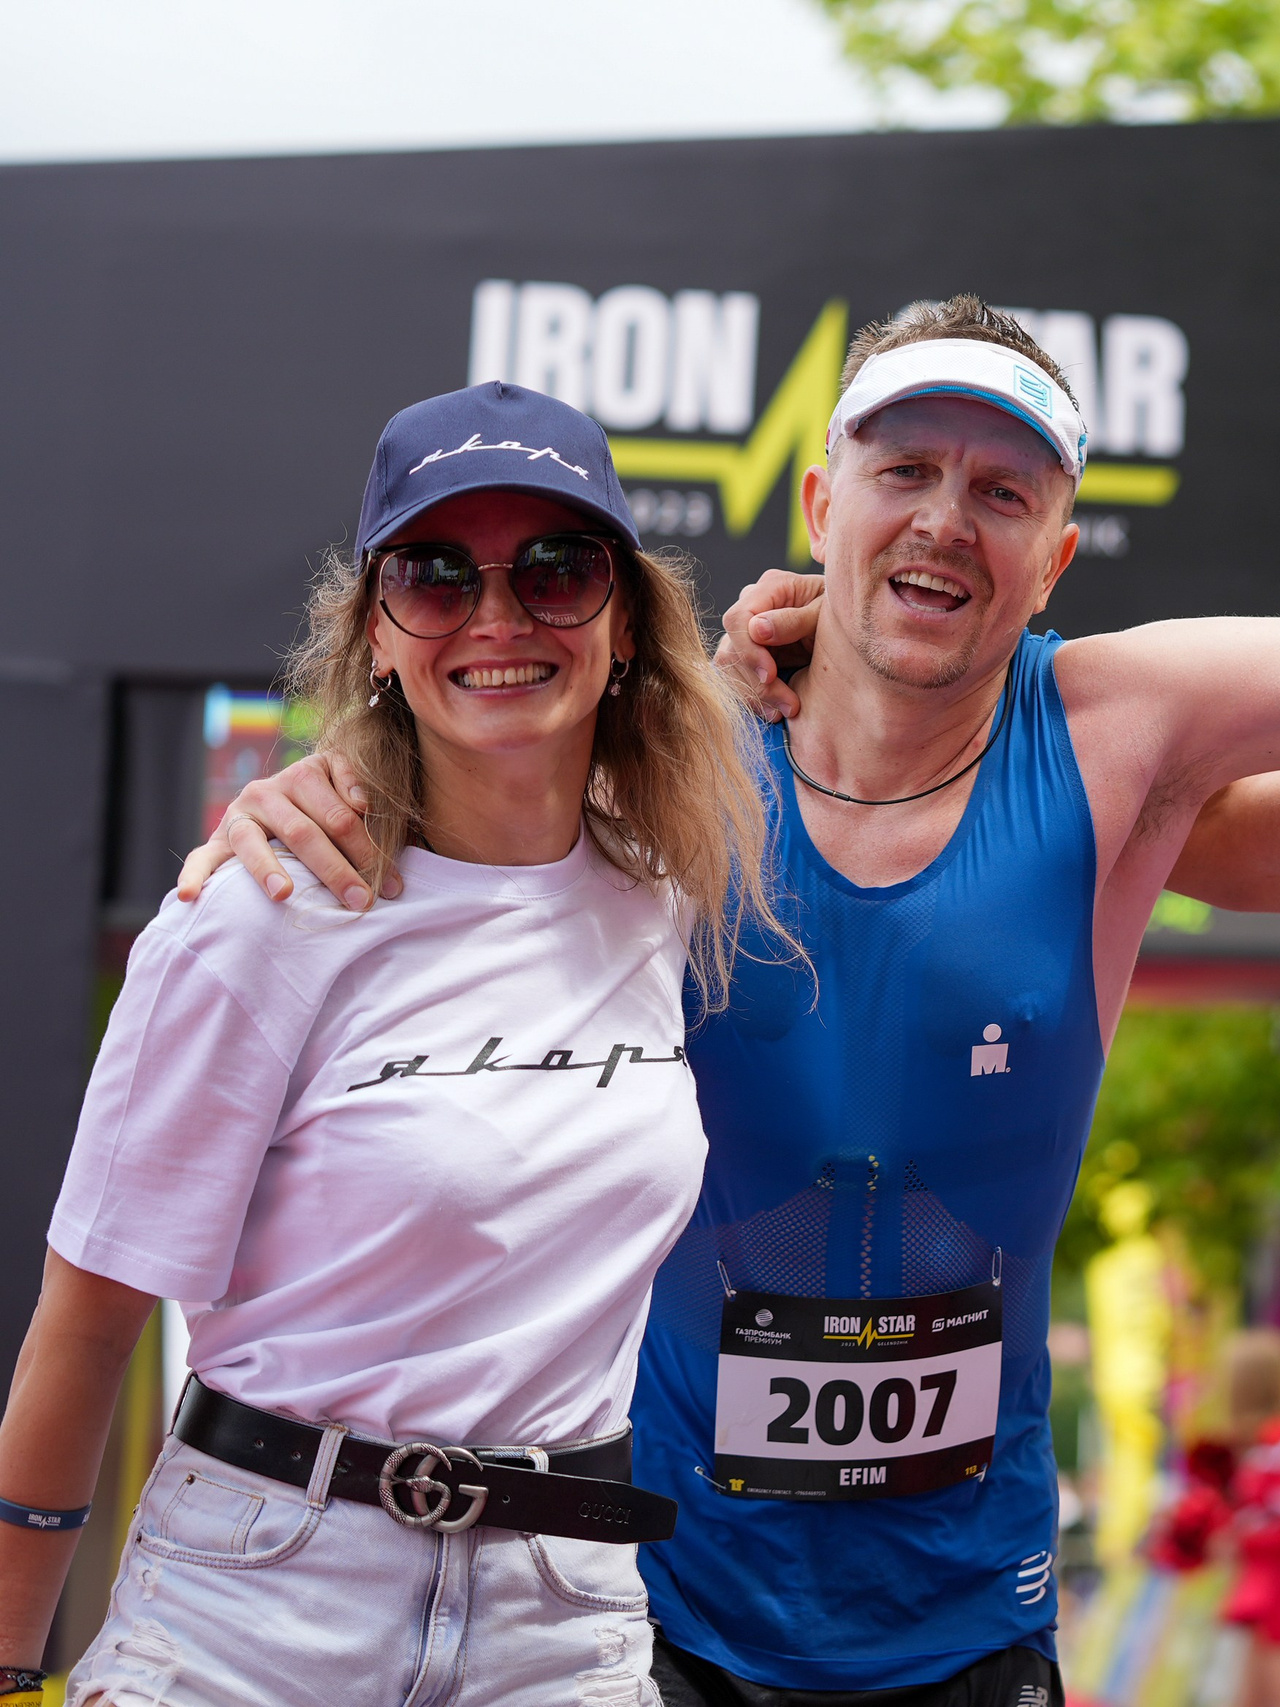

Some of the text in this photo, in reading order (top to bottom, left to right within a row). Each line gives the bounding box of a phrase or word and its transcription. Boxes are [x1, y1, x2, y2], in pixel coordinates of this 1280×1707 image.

[466, 278, 760, 434] IRON
[824, 1314, 916, 1334] IRON STAR
[946, 1309, 989, 1328] МАГНИТ
[735, 1327, 791, 1340] ГАЗПРОМБАНК
[744, 1335, 782, 1345] ПРЕМИУМ
[767, 1369, 958, 1446] 2007
[839, 1466, 887, 1486] EFIM
[577, 1501, 632, 1525] GUCCI
